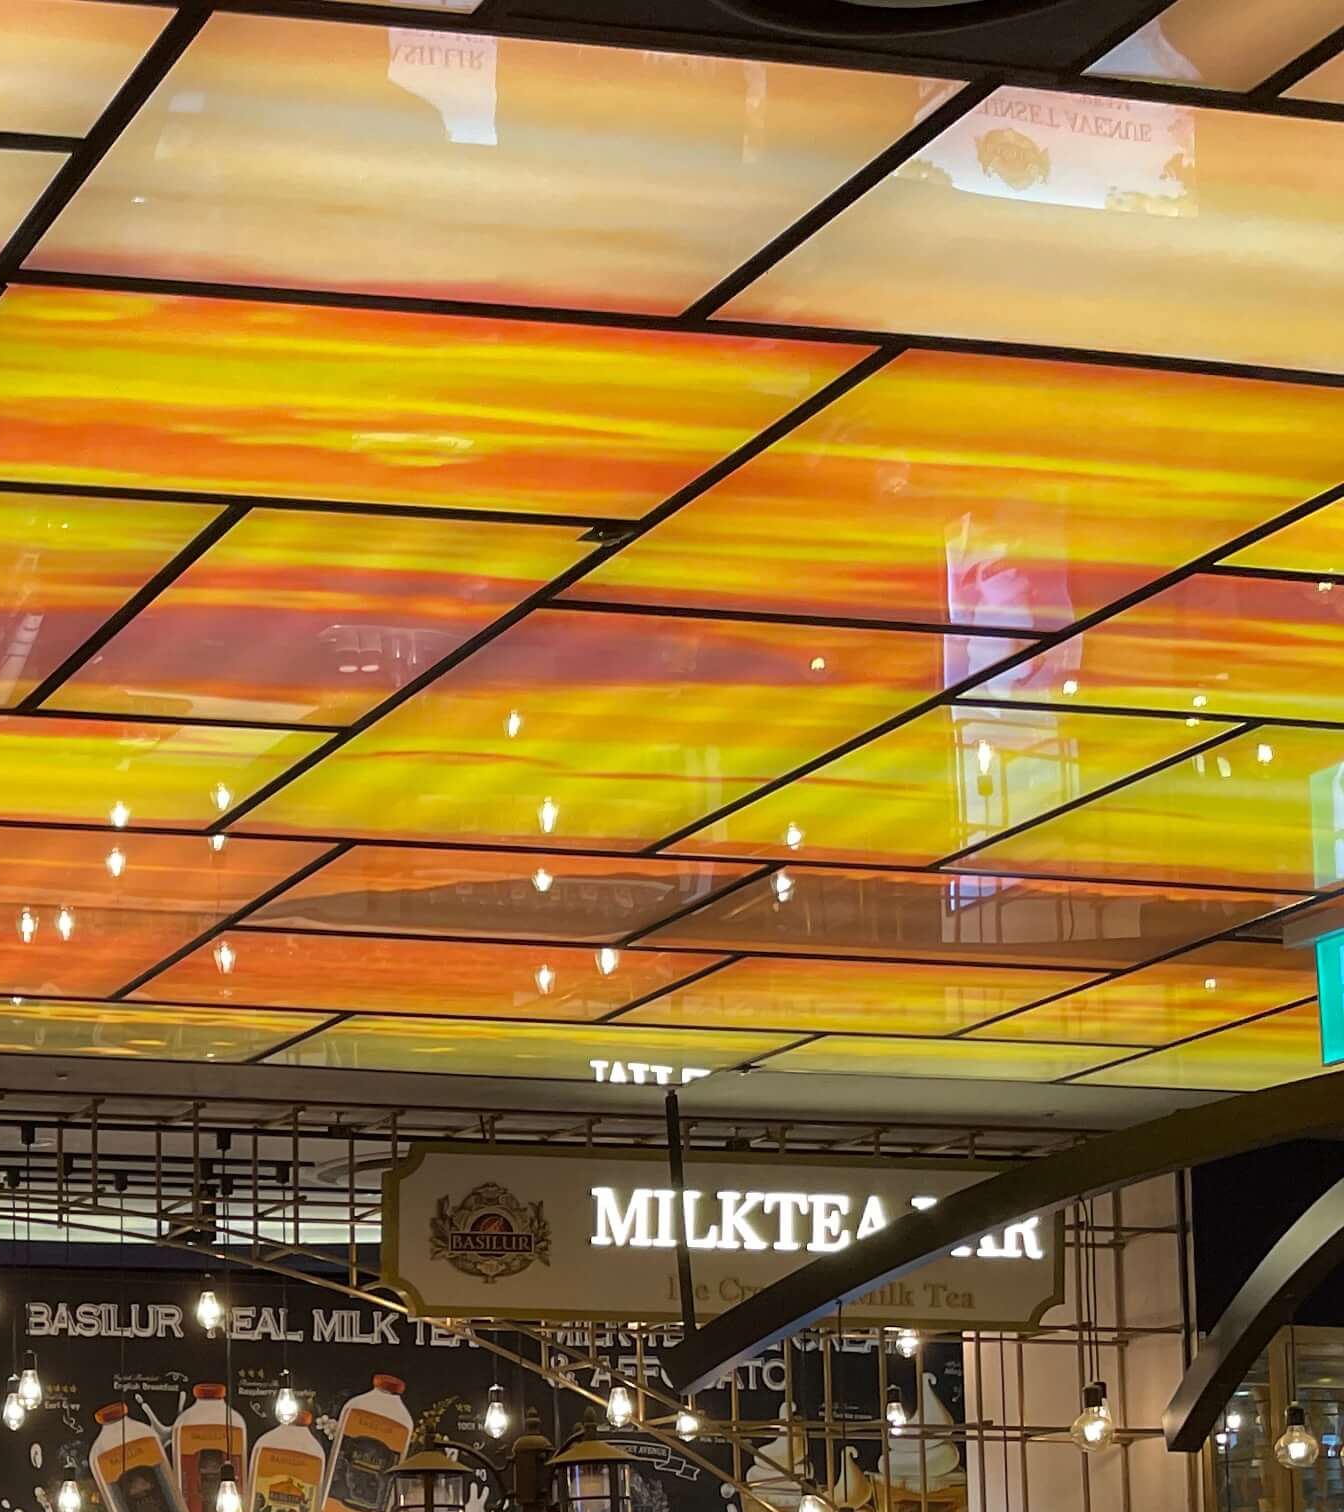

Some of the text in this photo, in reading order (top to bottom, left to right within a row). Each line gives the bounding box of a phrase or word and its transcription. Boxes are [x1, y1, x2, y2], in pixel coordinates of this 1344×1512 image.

[452, 1235, 531, 1252] BASILUR
[923, 1282, 976, 1310] Tea
[25, 1303, 185, 1338] BASILUR
[312, 1308, 401, 1345] MILK
